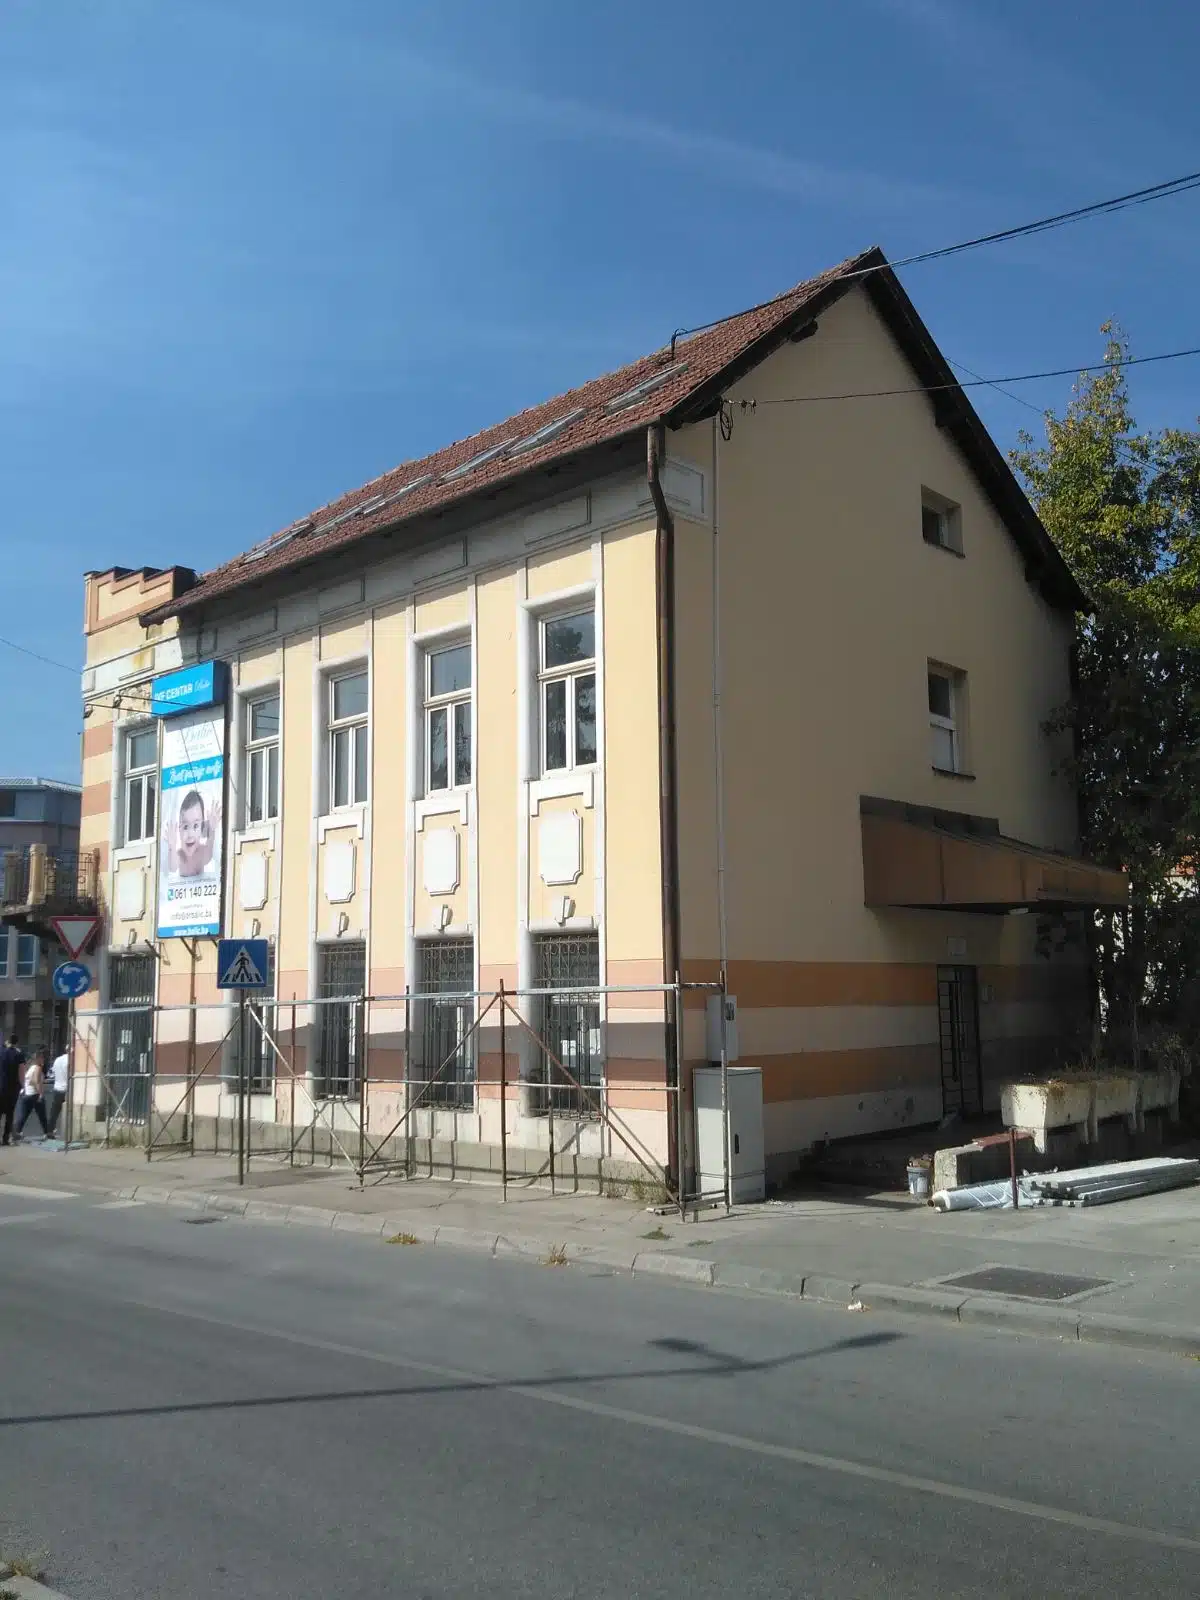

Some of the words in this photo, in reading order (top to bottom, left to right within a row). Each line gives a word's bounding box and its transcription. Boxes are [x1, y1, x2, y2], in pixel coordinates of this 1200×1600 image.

[166, 683, 193, 700] CENTAR
[175, 888, 187, 899] 061
[189, 887, 202, 898] 140
[203, 884, 217, 896] 222
